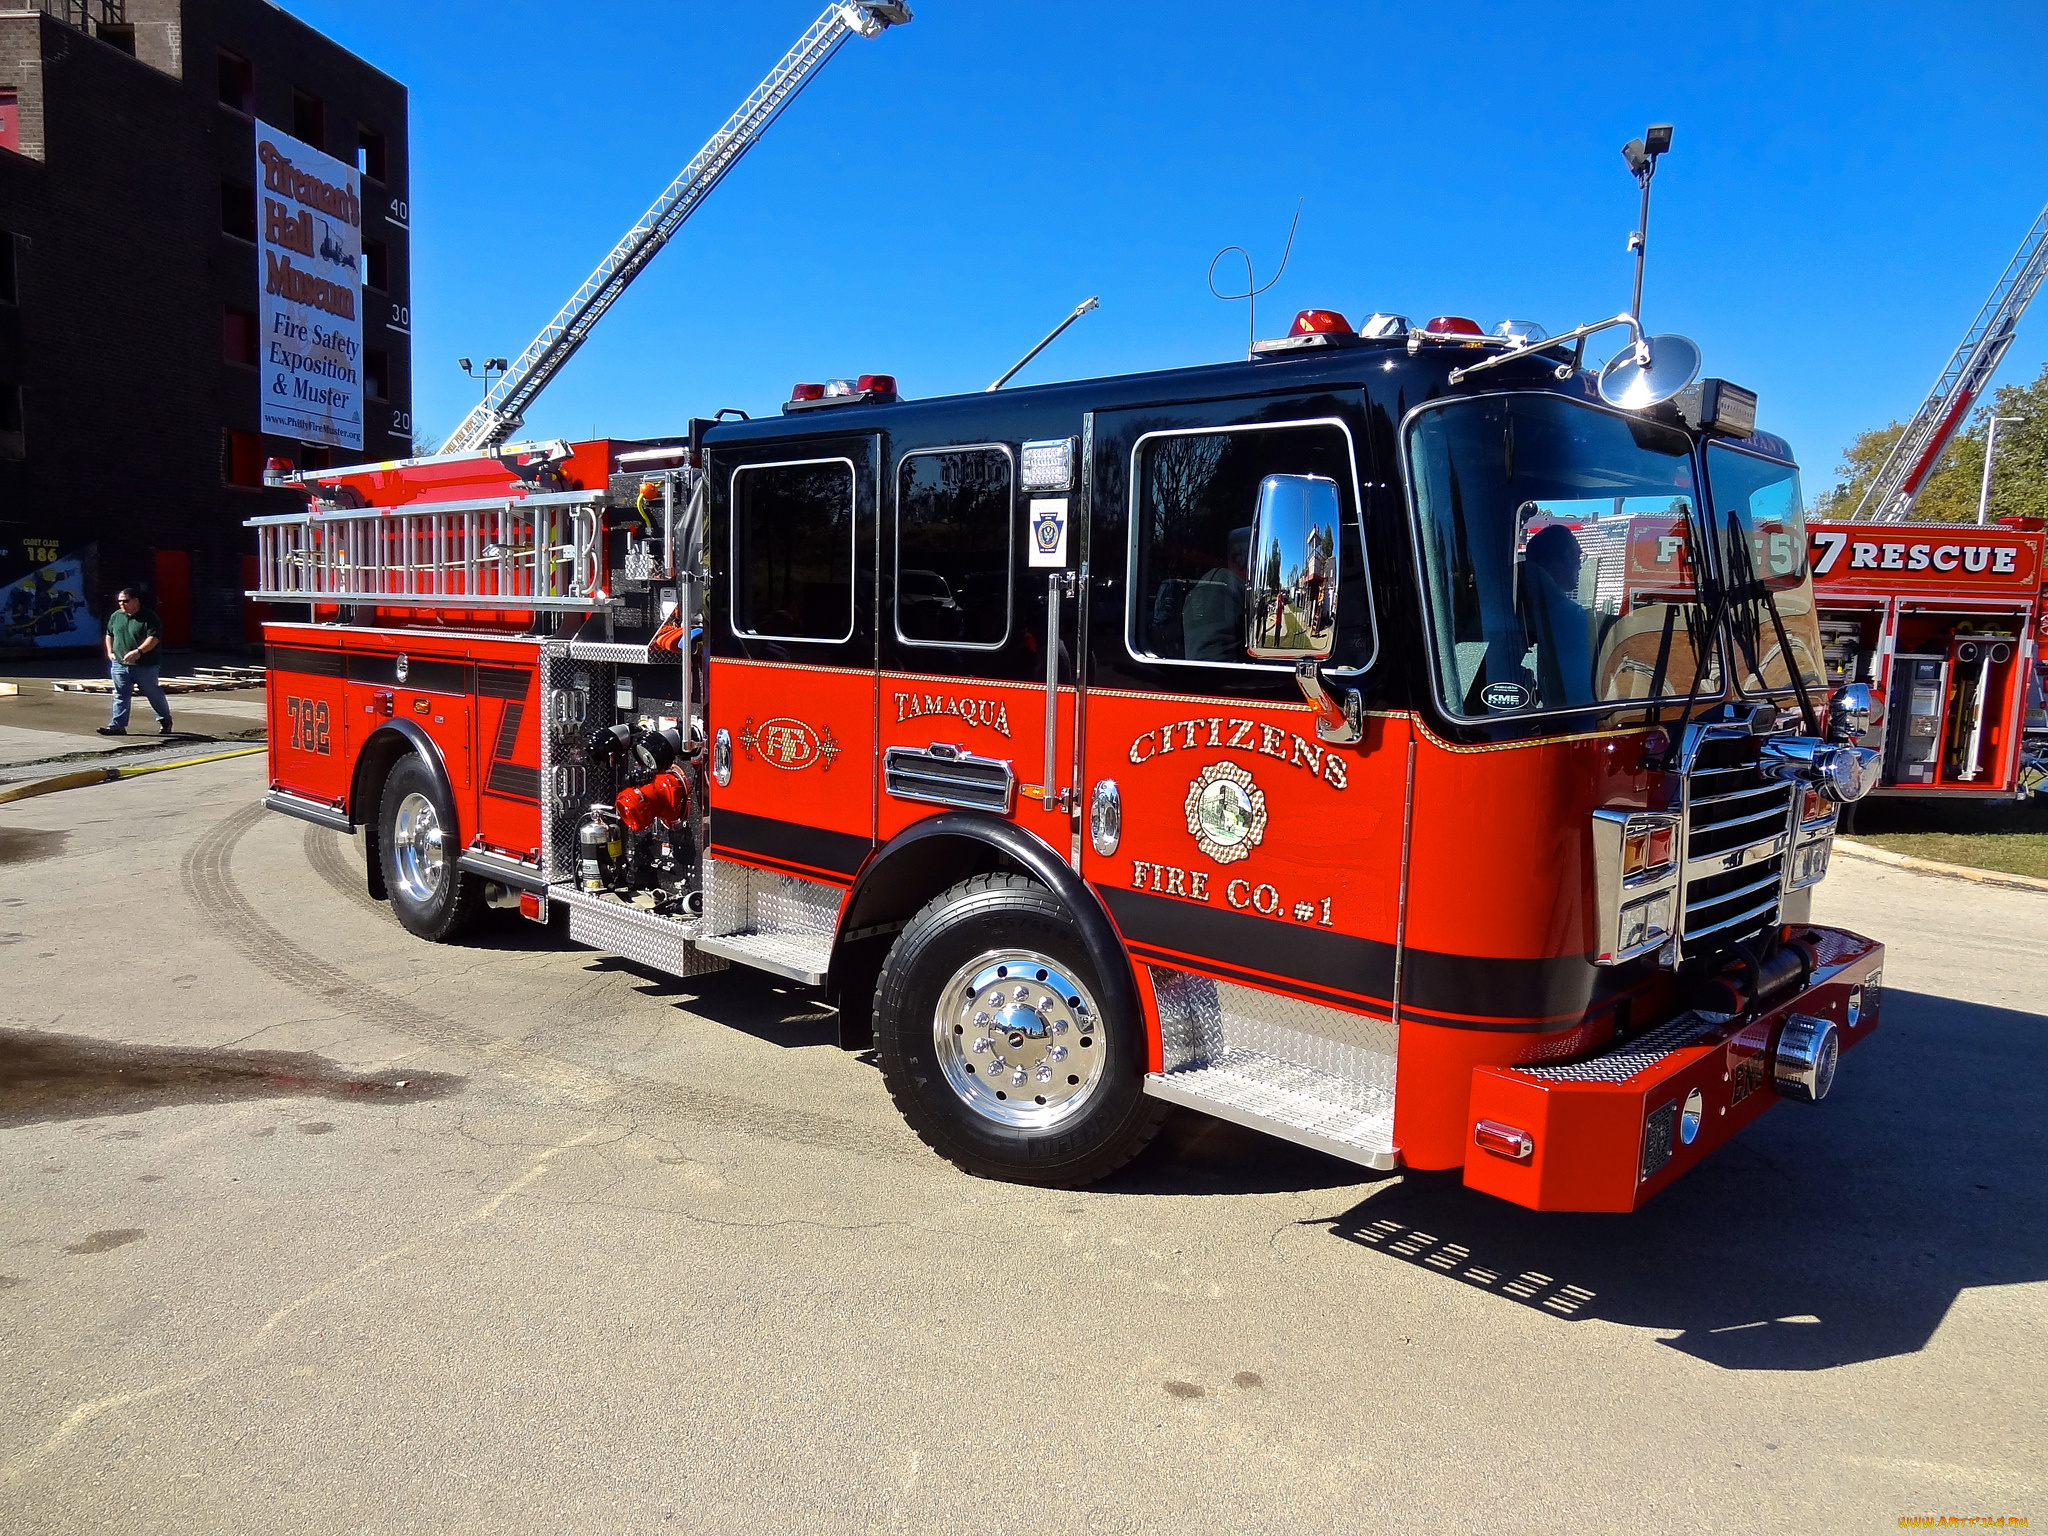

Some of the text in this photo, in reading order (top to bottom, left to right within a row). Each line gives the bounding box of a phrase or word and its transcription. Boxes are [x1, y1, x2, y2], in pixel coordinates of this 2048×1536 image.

[258, 140, 360, 228] Fireman's
[264, 197, 315, 258] Hall
[390, 198, 408, 220] 40
[265, 249, 355, 321] Museum
[273, 311, 360, 361] Fire Safety
[391, 304, 409, 326] 30
[268, 341, 358, 384] Exposition
[272, 373, 350, 410] & Muster
[264, 412, 362, 443] www.PhillyFireMuster.org
[393, 410, 410, 430] 20
[27, 547, 57, 562] 186
[1852, 542, 2017, 574] RESCUE
[894, 692, 1012, 738] TAMAQUA
[1488, 694, 1520, 702] KME
[287, 695, 330, 756] 782
[1129, 717, 1348, 790] CITIZENS
[1131, 860, 1334, 926] FIRE CO. #1
